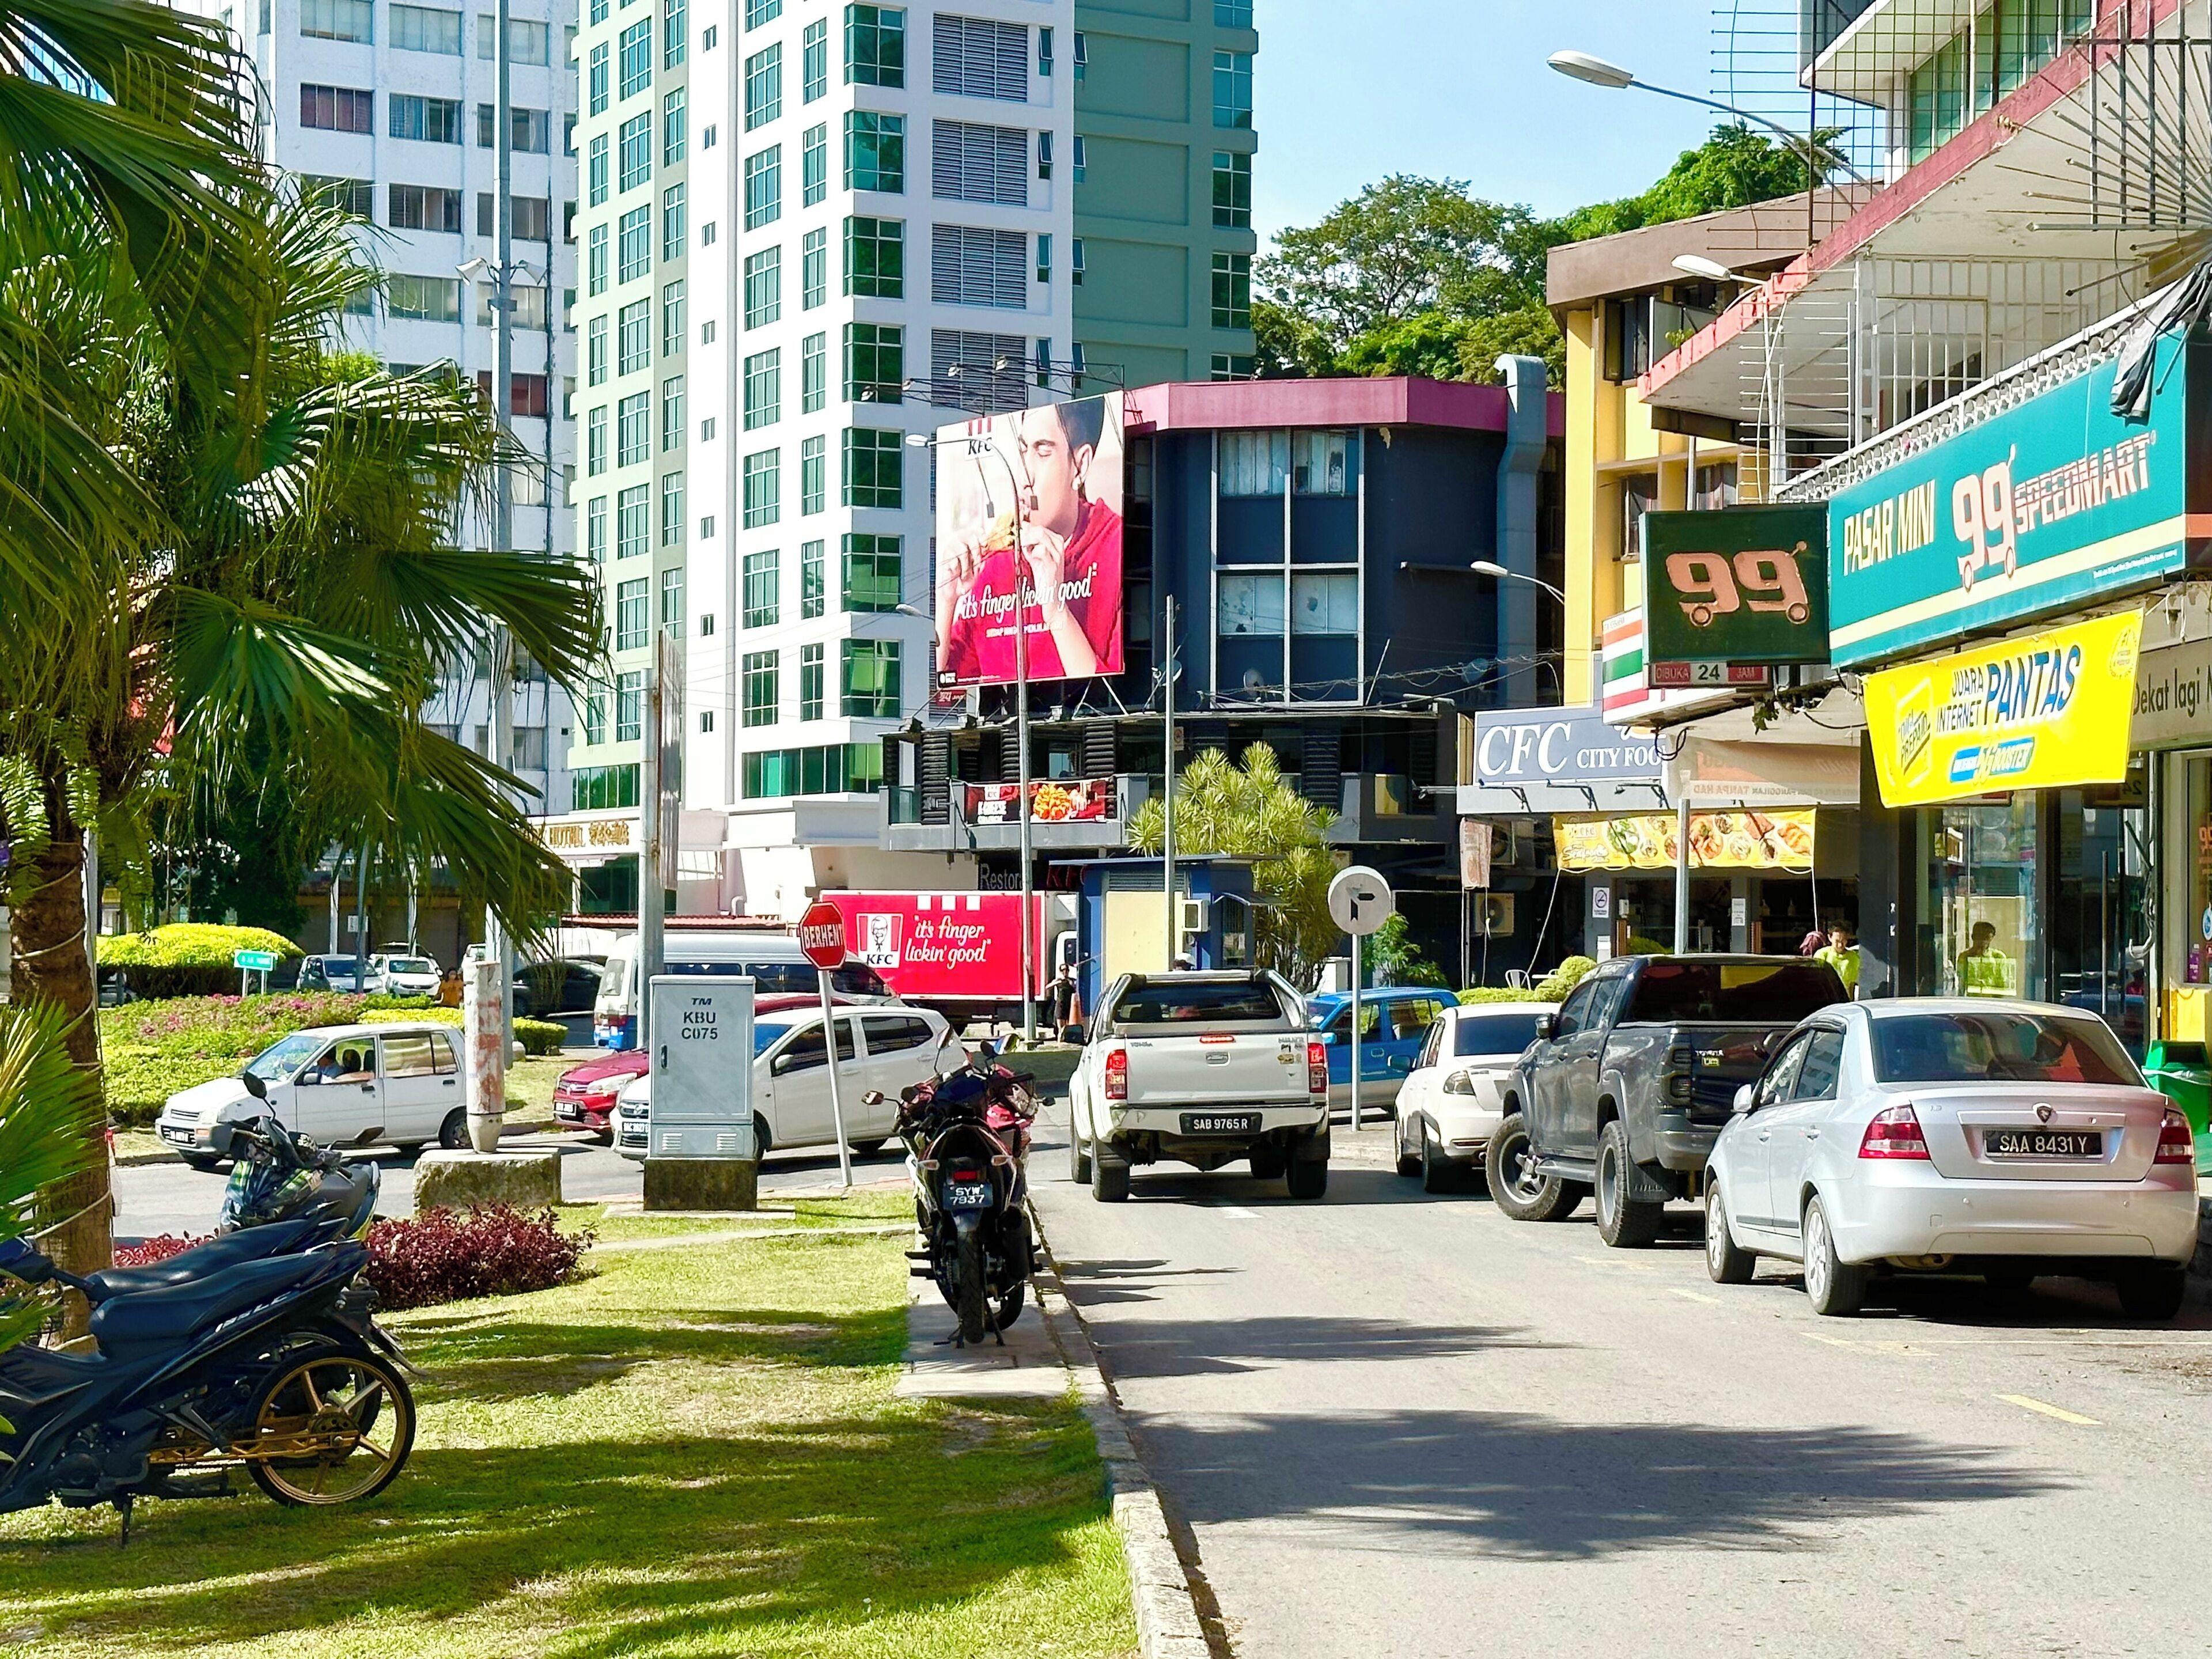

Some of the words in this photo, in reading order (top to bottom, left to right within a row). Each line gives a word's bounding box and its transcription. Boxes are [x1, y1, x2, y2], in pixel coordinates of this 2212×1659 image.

[968, 437, 992, 455] KFC
[1843, 498, 1893, 577] PASAR
[1897, 479, 1936, 555] MINI
[1952, 444, 2016, 592] 99
[2015, 433, 2149, 535] SPEEDMART
[1665, 540, 1809, 627] 99
[980, 584, 1018, 624] finger
[1656, 667, 1689, 680] DIBUKA
[1698, 664, 1720, 680] 24
[1737, 667, 1754, 679] JAM
[1952, 667, 1983, 698] JUARA
[1984, 645, 2081, 725] PANTAS
[2133, 673, 2169, 715] Dekat
[2175, 667, 2200, 718] lagi
[1936, 699, 1982, 733] INTERNET
[1479, 723, 1571, 776] CFC
[1577, 748, 1621, 768] CITY
[1624, 747, 1664, 766] FOO
[980, 863, 1022, 890] Restor
[938, 915, 984, 946] finger
[866, 954, 893, 965] KFC
[691, 998, 711, 1006] TM
[684, 1012, 715, 1024] KBU
[681, 1027, 718, 1040] C075
[1194, 1118, 1212, 1130] SAB
[1214, 1118, 1240, 1130] 9765
[1241, 1118, 1248, 1129] R
[2000, 1135, 2030, 1153] SAA
[2035, 1136, 2073, 1153] 8431
[2078, 1136, 2087, 1153] Y
[950, 1194, 985, 1206] 7937
